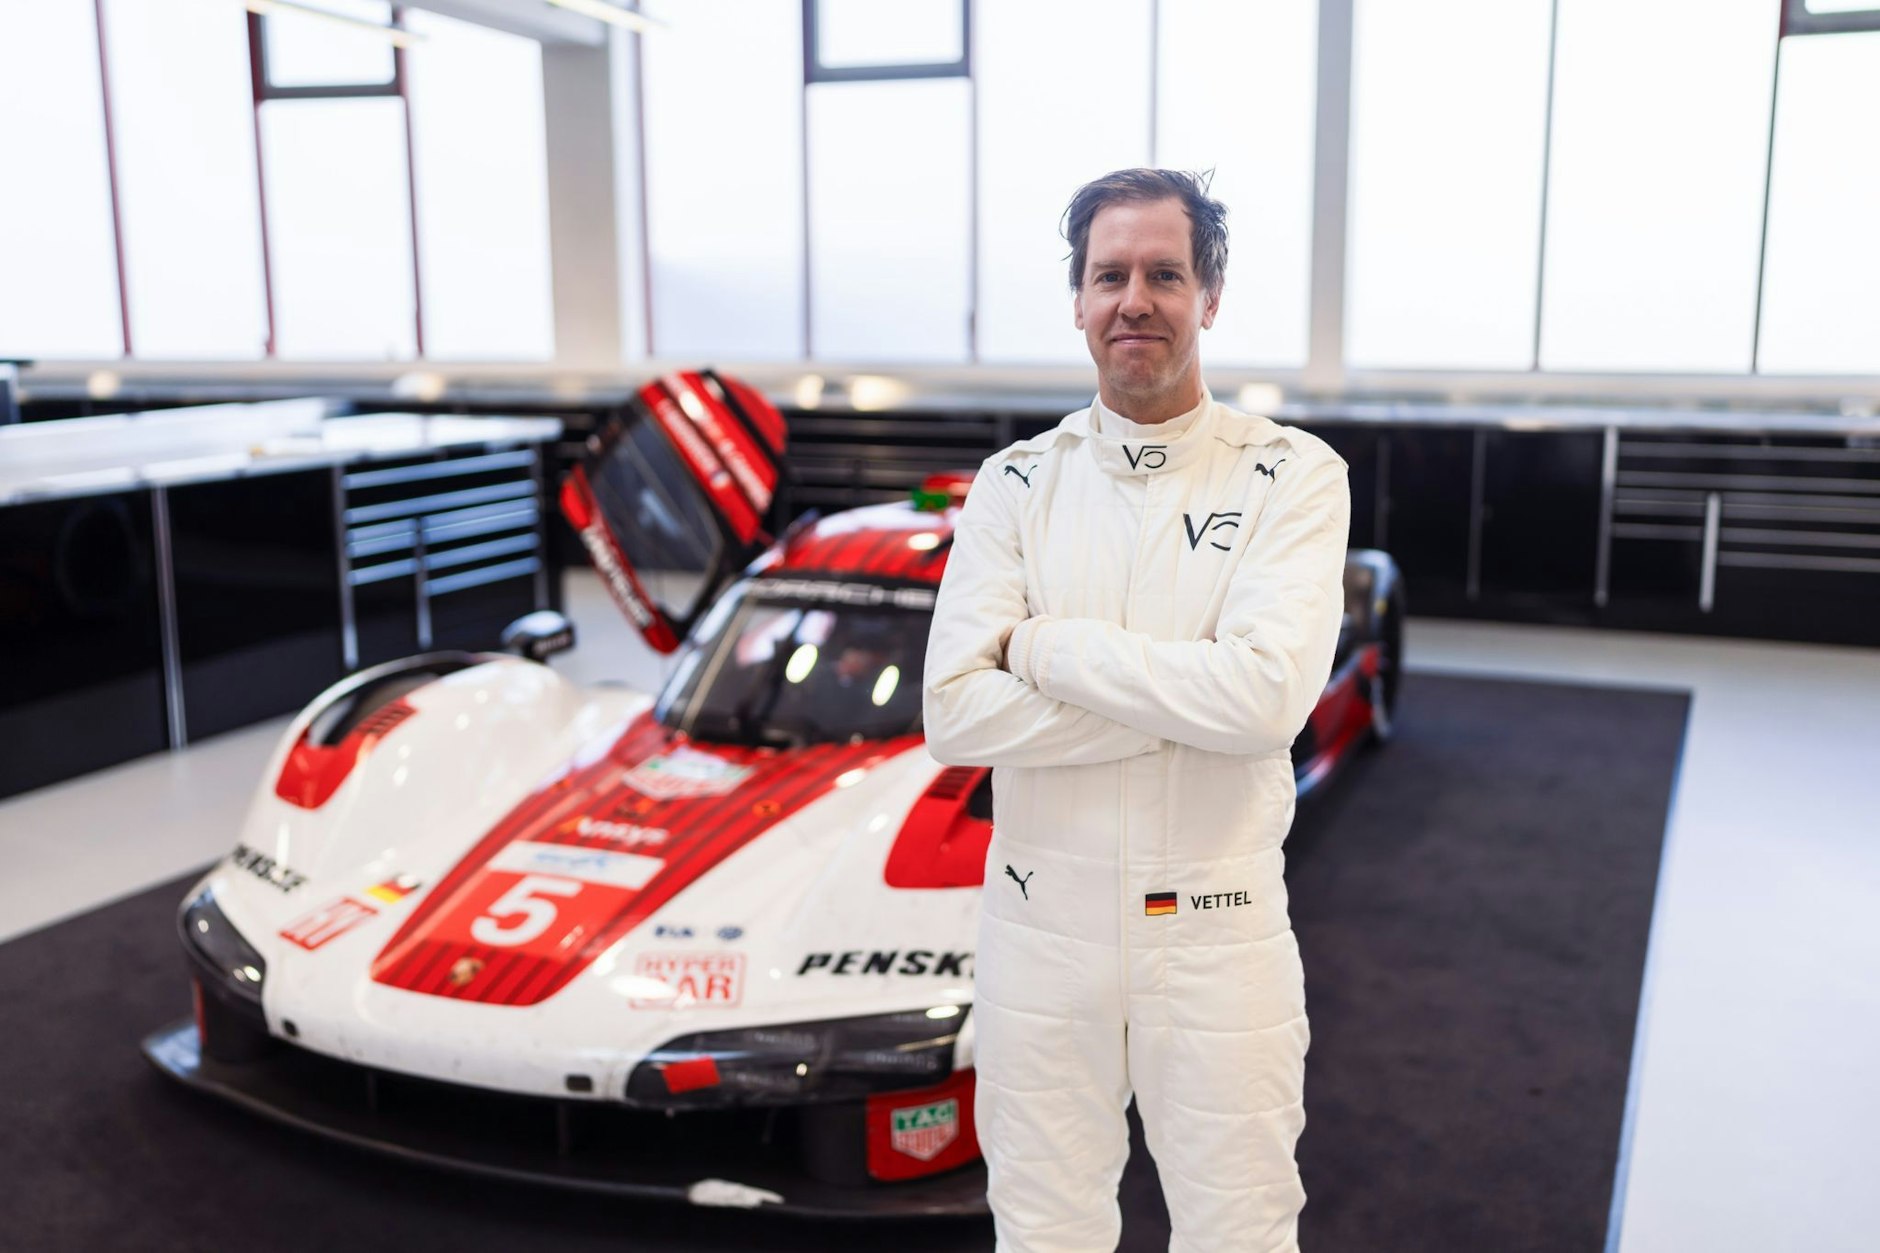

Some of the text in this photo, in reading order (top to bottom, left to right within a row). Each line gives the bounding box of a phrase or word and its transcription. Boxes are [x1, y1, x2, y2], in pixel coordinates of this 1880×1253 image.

[470, 874, 583, 947] 5
[1190, 890, 1252, 911] VETTEL
[797, 950, 975, 977] PENSK
